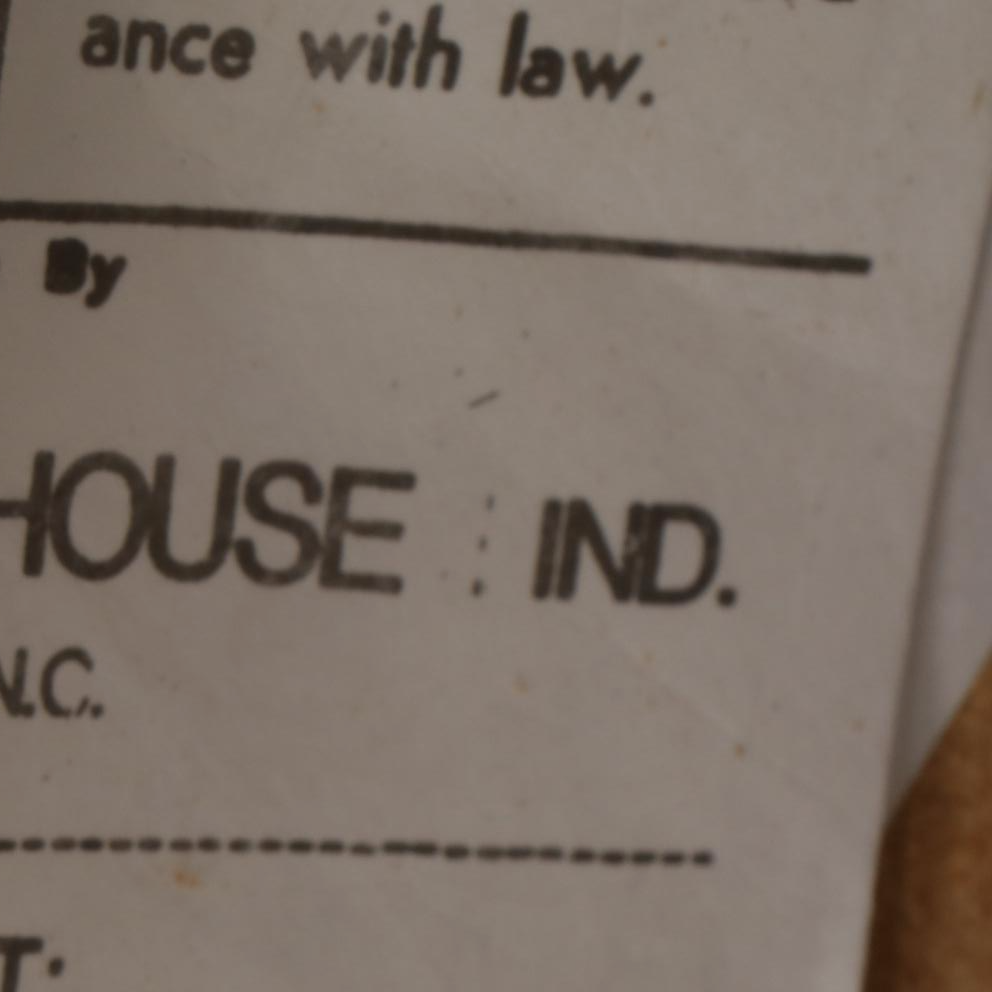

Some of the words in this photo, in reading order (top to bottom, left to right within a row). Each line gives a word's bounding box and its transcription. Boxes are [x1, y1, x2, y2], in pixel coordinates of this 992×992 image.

[80, 15, 256, 80] ance
[299, 4, 462, 91] with
[498, 10, 654, 107] law.
[44, 237, 127, 309] By
[532, 498, 737, 608] IND.
